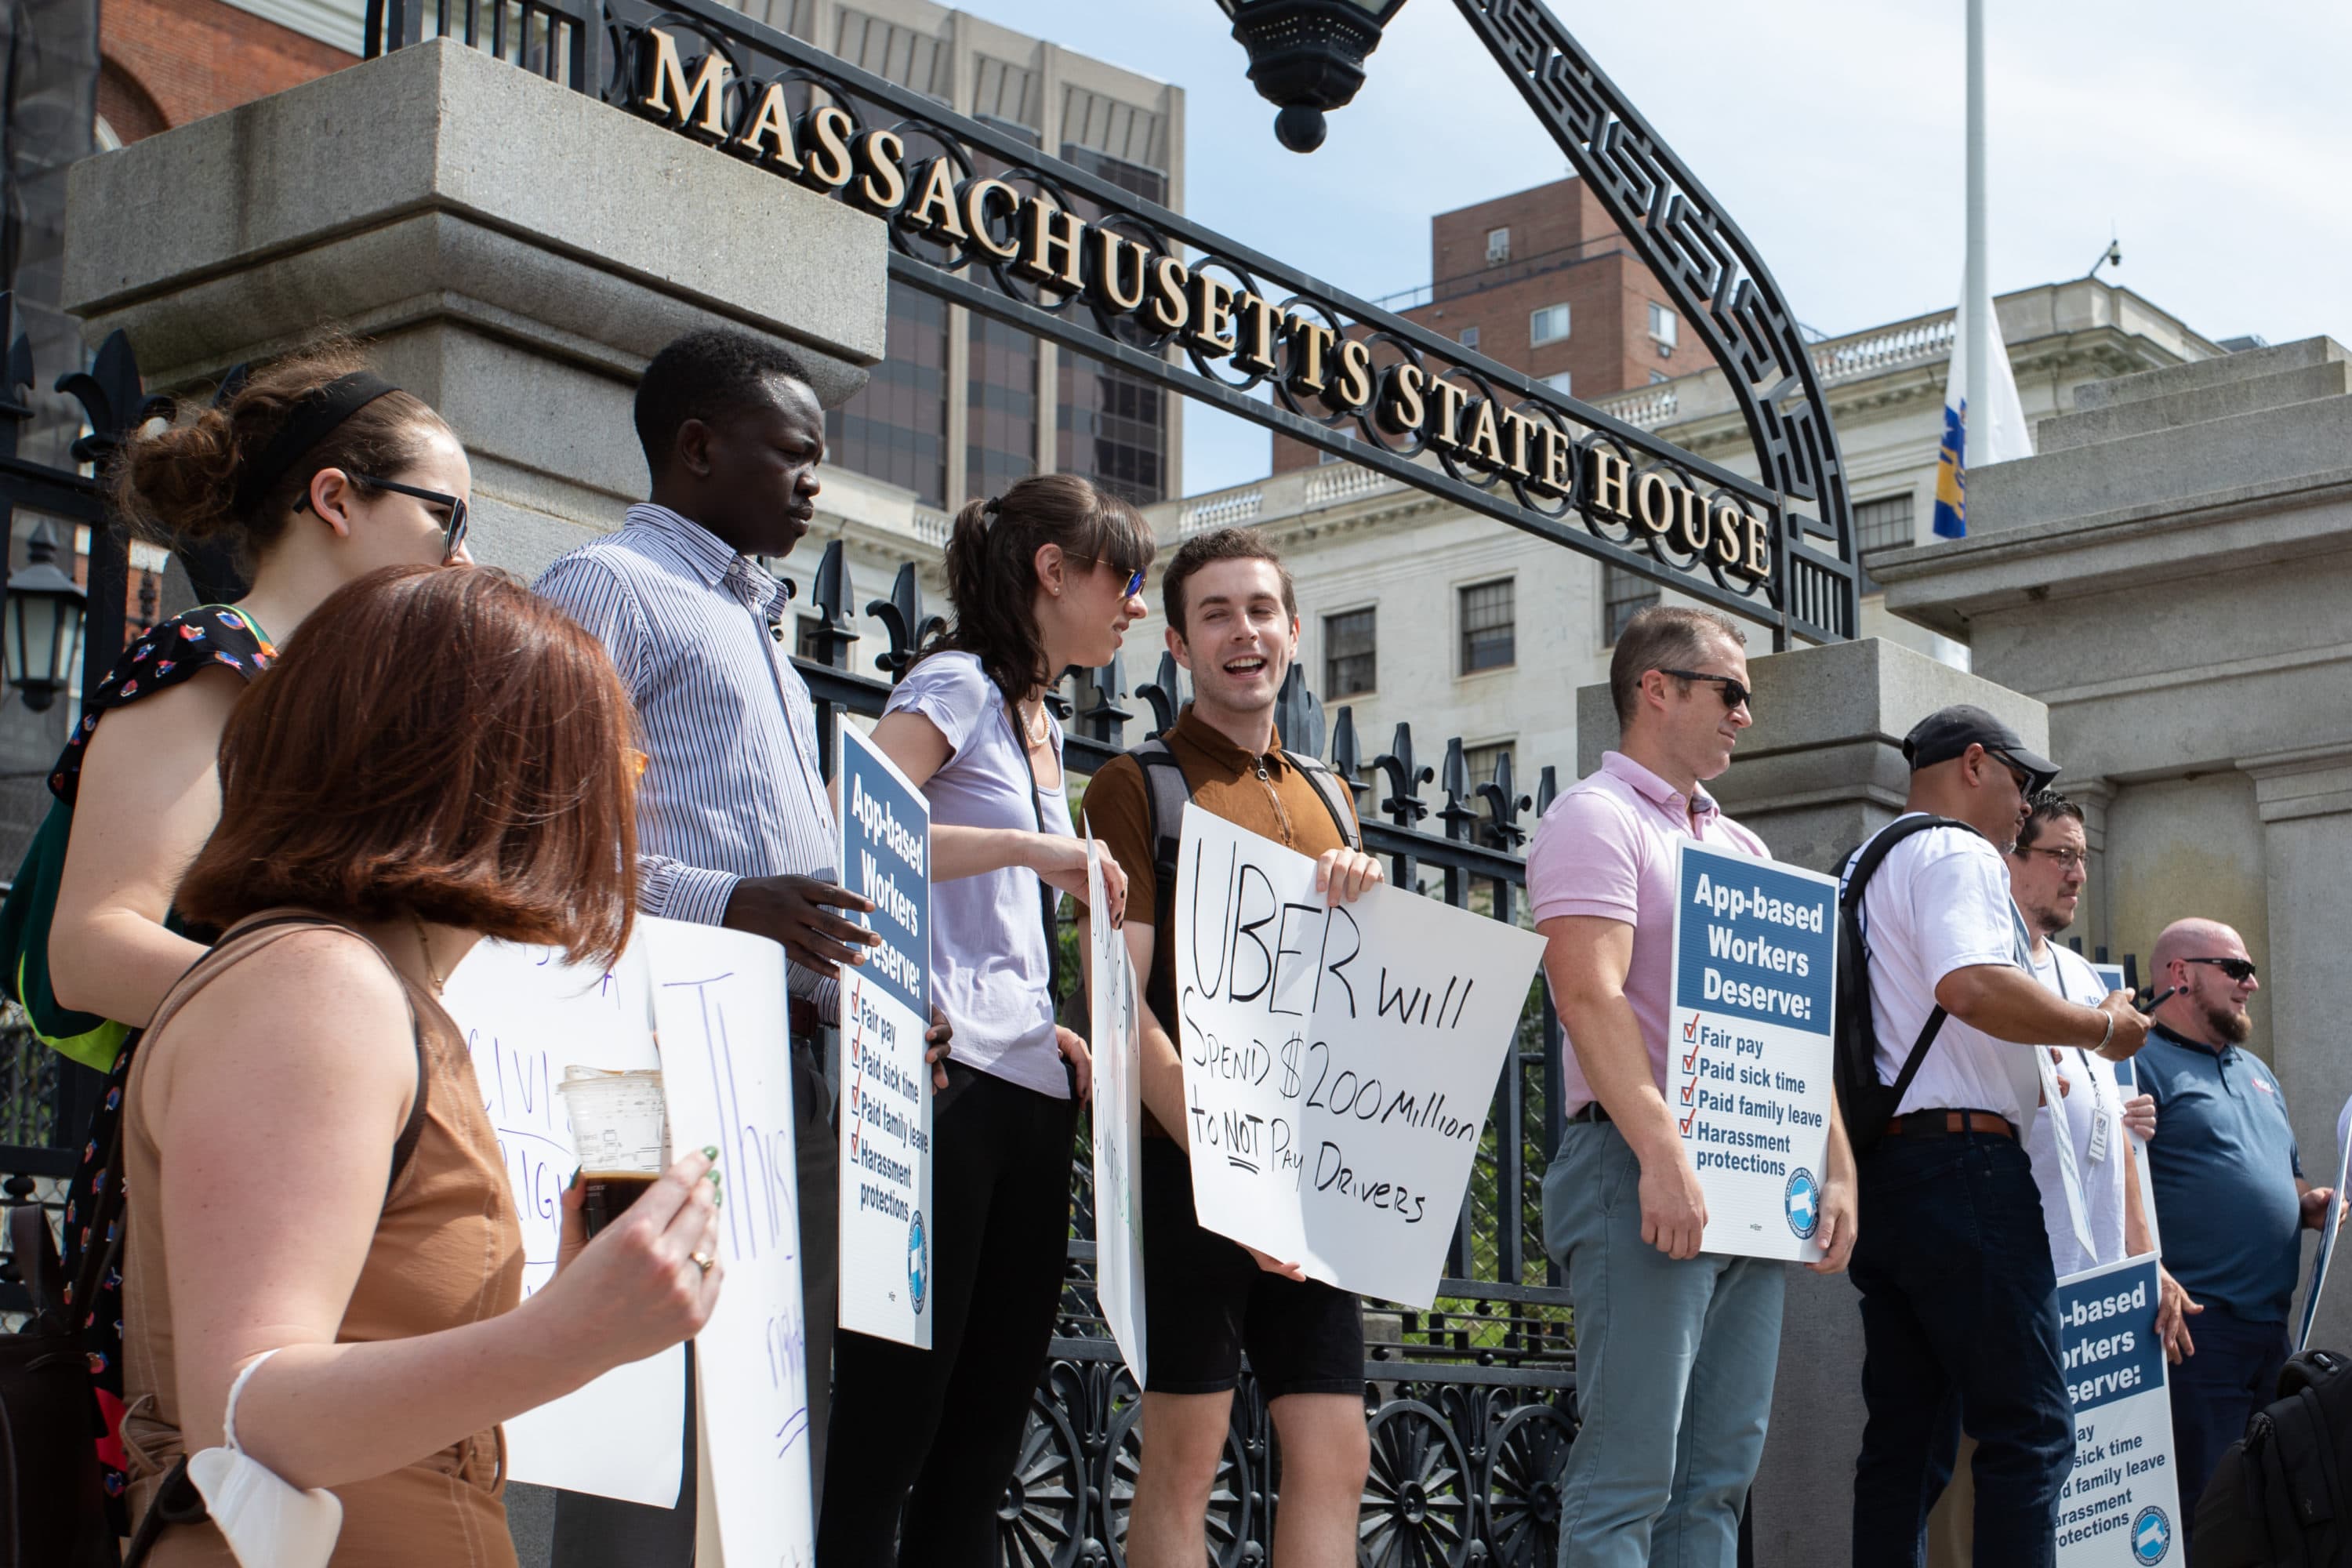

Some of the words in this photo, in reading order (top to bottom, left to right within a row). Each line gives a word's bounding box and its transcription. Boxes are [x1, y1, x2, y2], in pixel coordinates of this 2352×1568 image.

[644, 27, 1372, 408] MASSACHUSETTS
[1396, 364, 1573, 497] STATE
[1594, 447, 1772, 579] HOUSE
[851, 773, 924, 878] App-based
[861, 848, 919, 938] Workers
[1693, 873, 1824, 934] App-based
[861, 912, 920, 1000] Deserve:
[1192, 837, 1362, 1018] UBER
[1377, 967, 1474, 1029] will
[1708, 924, 1809, 977] Workers
[1703, 967, 1811, 1020] Deserve:
[861, 996, 879, 1034] Fair
[881, 1018, 896, 1051] pay
[1700, 1025, 1731, 1050] Fair
[1737, 1037, 1763, 1059] pay
[861, 1045, 881, 1084] Paid
[883, 1062, 901, 1098] sick
[902, 1071, 919, 1105] time
[1183, 985, 1272, 1086] SPEND
[1279, 1029, 1382, 1121] $200
[1381, 1091, 1475, 1142] Million
[1700, 1057, 1734, 1083] Paid
[1740, 1065, 1771, 1088] sick
[1776, 1070, 1806, 1094] time
[861, 1091, 881, 1129] Paid
[883, 1102, 908, 1149] family
[909, 1118, 929, 1155] leave
[1224, 1109, 1265, 1158] NOT
[1698, 1089, 1733, 1114] Paid
[1739, 1097, 1784, 1126] family
[1788, 1104, 1823, 1128] leave
[861, 1138, 911, 1189] Harassment
[1697, 1121, 1791, 1153] Harassment
[1697, 1150, 1786, 1177] protections
[860, 1181, 909, 1222] protections
[2074, 1445, 2106, 1468] sick
[2110, 1435, 2143, 1456] time
[2076, 1466, 2122, 1494] family
[2127, 1454, 2165, 1478] leave
